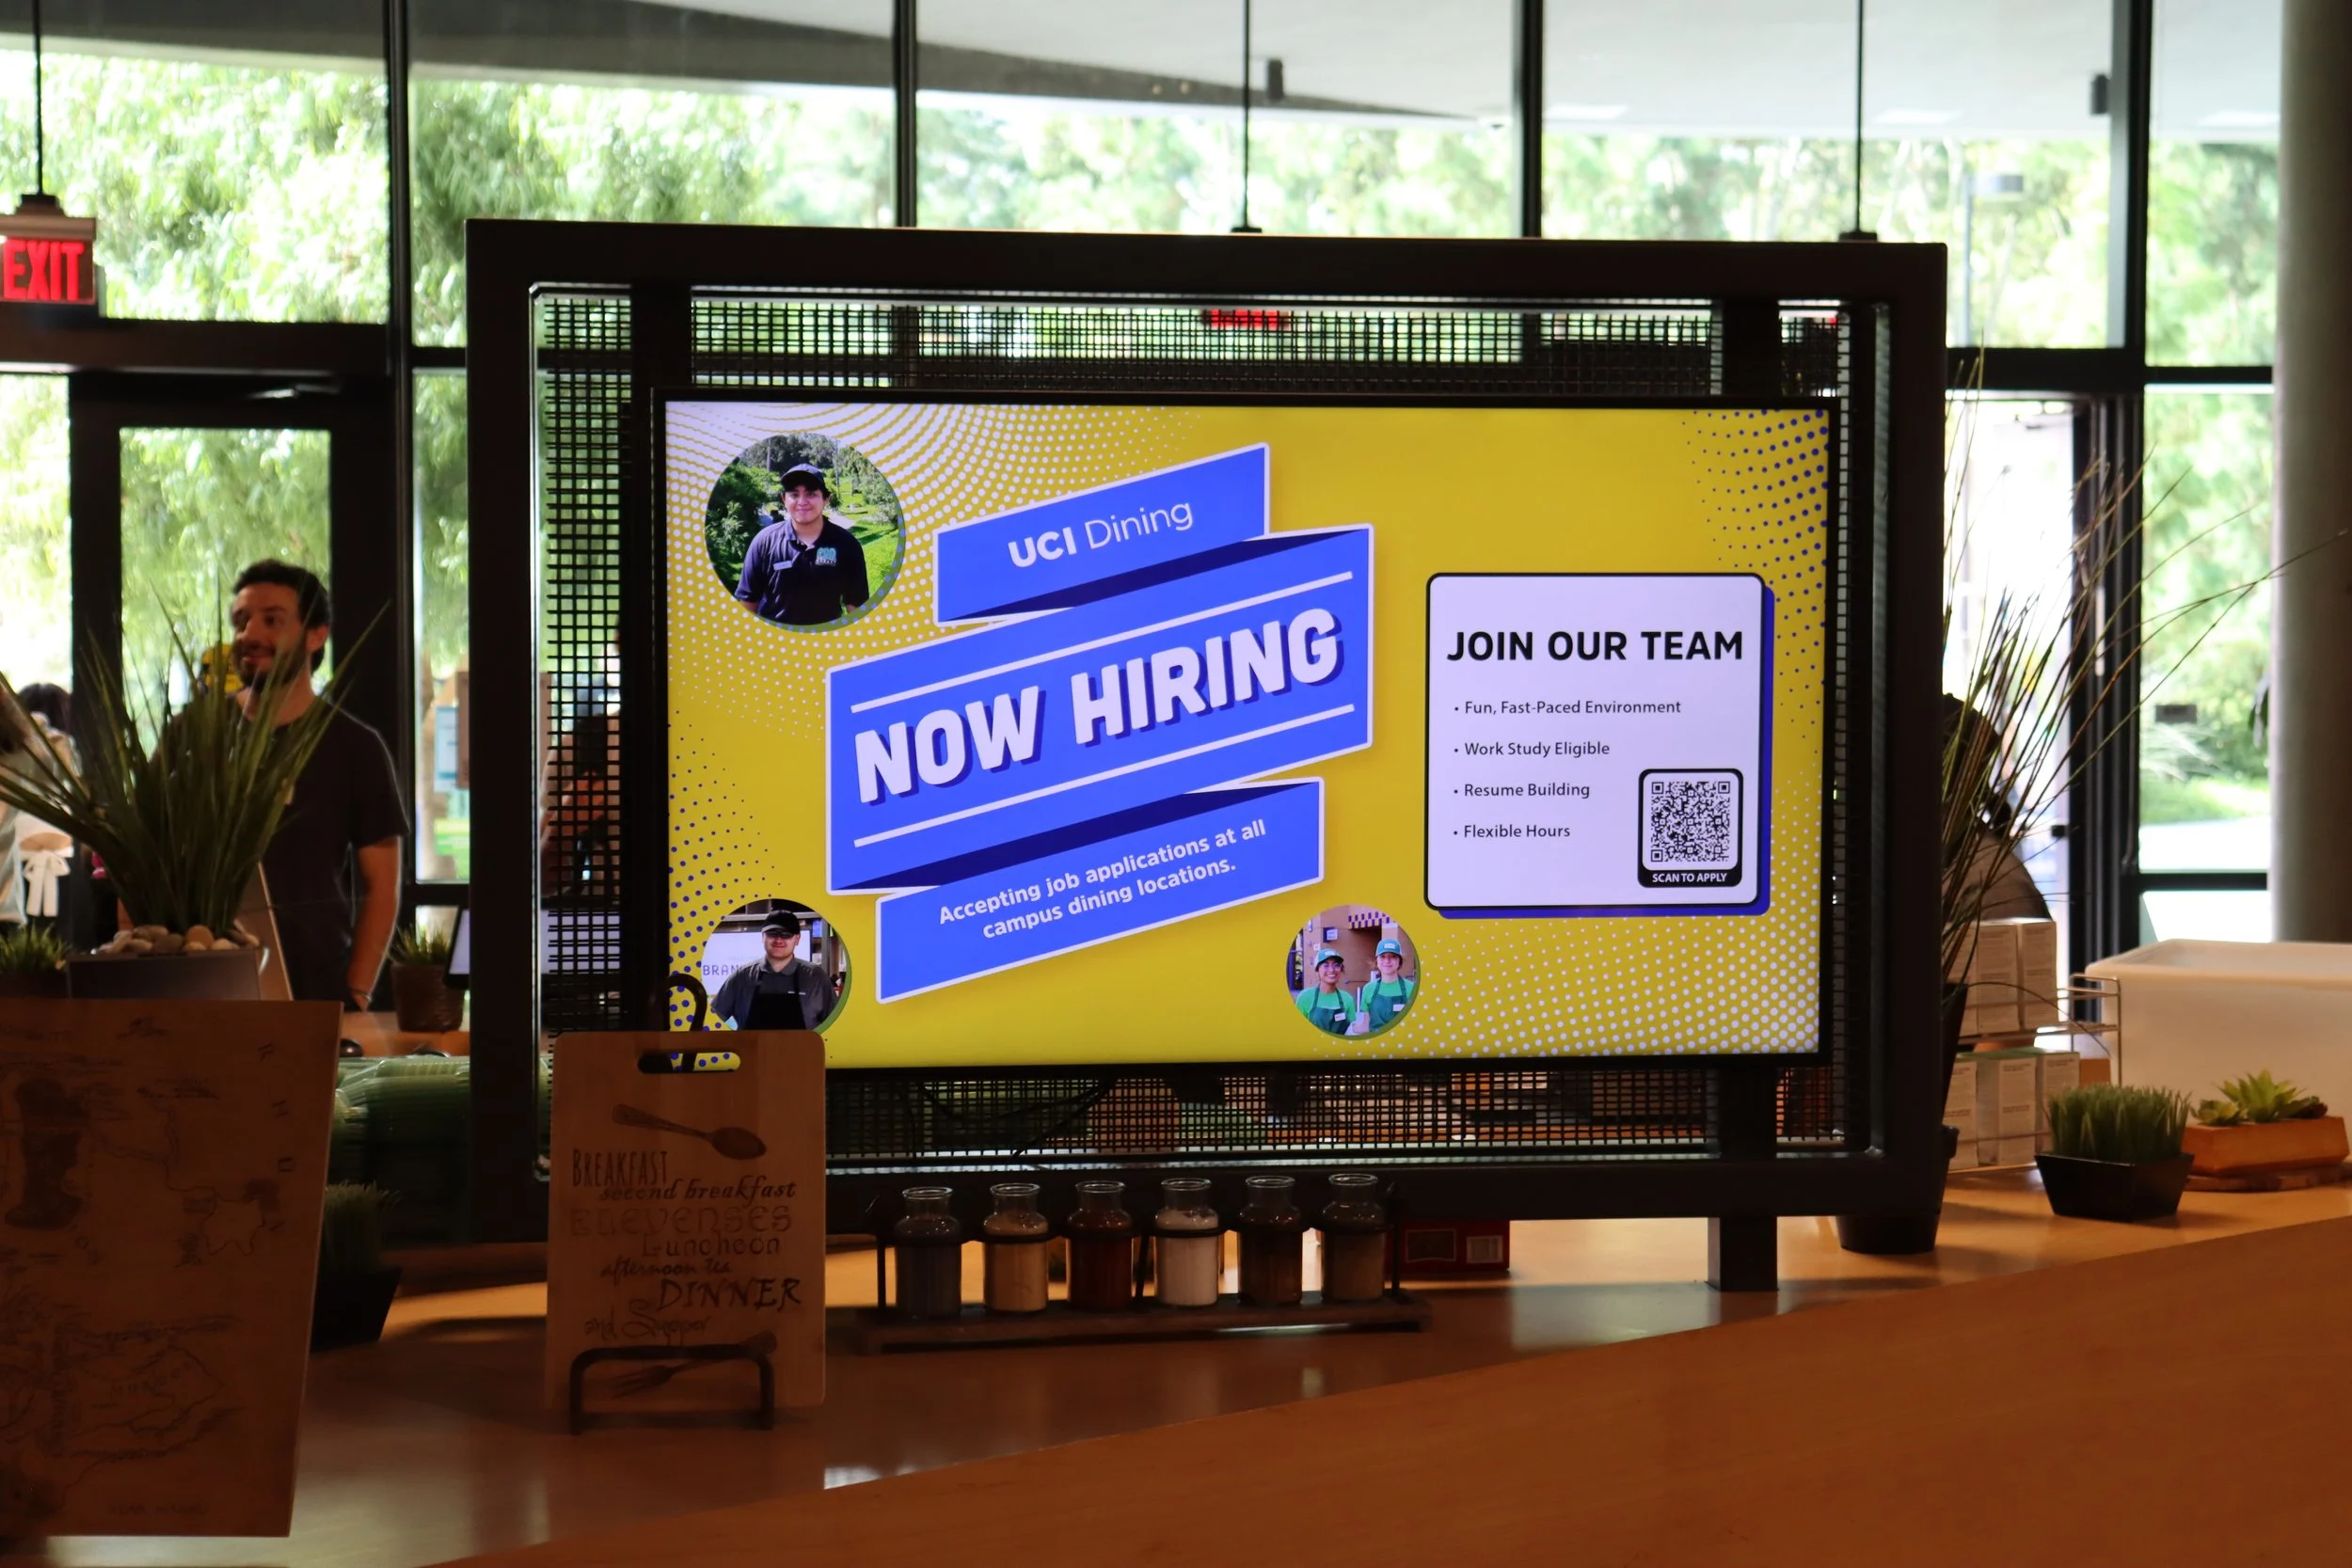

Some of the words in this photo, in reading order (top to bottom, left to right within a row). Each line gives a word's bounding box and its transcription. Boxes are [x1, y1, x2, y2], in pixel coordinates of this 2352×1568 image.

[3, 239, 85, 301] EXIT
[1008, 526, 1077, 568] UCI
[1084, 502, 1194, 550] Dining
[1446, 630, 1534, 661] JOIN
[1548, 630, 1628, 661] OUR
[1640, 630, 1743, 660] TEAM
[854, 685, 1041, 803] NOW
[1071, 608, 1339, 745] HIRING
[1464, 701, 1497, 716] Fun,
[1501, 700, 1581, 714] Fast-Paced
[1585, 700, 1681, 714] Environment
[1464, 741, 1504, 755] Work
[1507, 741, 1551, 759] Study
[1554, 740, 1611, 759] Eligible
[1464, 784, 1524, 797] Resume
[1528, 782, 1590, 800] Building
[1464, 824, 1522, 838] Flexible
[1526, 824, 1570, 837] Hours
[940, 884, 1041, 925] Accepting
[1045, 872, 1080, 897] job
[1085, 838, 1211, 884] applications
[1215, 828, 1237, 847] at
[1241, 818, 1266, 841] all
[1652, 873, 1679, 883] SCAN
[1680, 873, 1695, 883] TO
[1696, 872, 1727, 883] APPLY
[983, 905, 1063, 939] campus
[1068, 886, 1134, 915] dining
[1136, 859, 1237, 896] locations.
[572, 1148, 668, 1187] BREAKFAST
[599, 1178, 684, 1201] second
[685, 1174, 797, 1208] breakfast
[642, 1231, 781, 1259] Luncheon
[599, 1255, 698, 1286] afternoon
[703, 1258, 733, 1275] tea
[657, 1277, 803, 1312] DINNER
[584, 1307, 618, 1340] and
